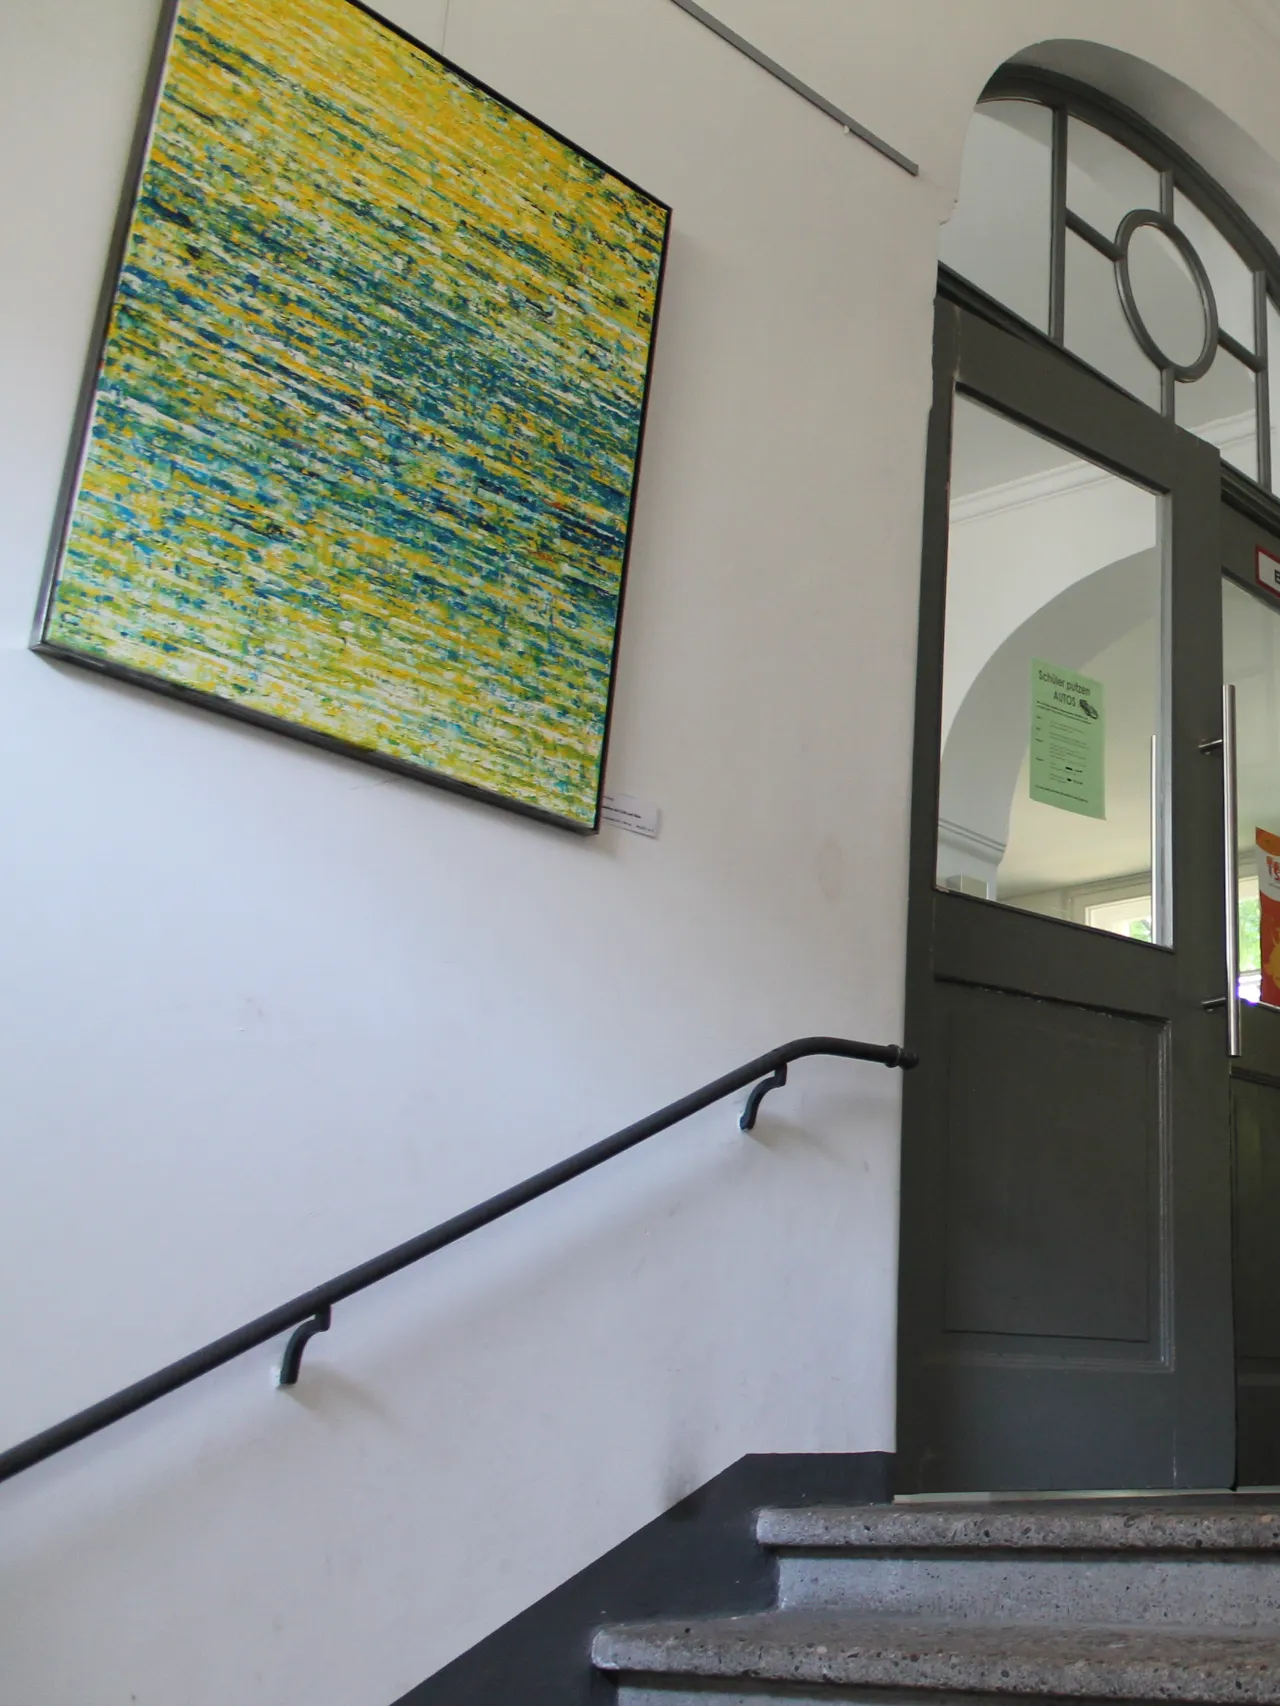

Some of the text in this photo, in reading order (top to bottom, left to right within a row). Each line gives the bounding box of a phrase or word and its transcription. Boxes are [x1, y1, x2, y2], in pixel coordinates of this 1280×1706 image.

[1038, 669, 1091, 696] Schüler putzen
[1053, 690, 1076, 707] AUTOS
